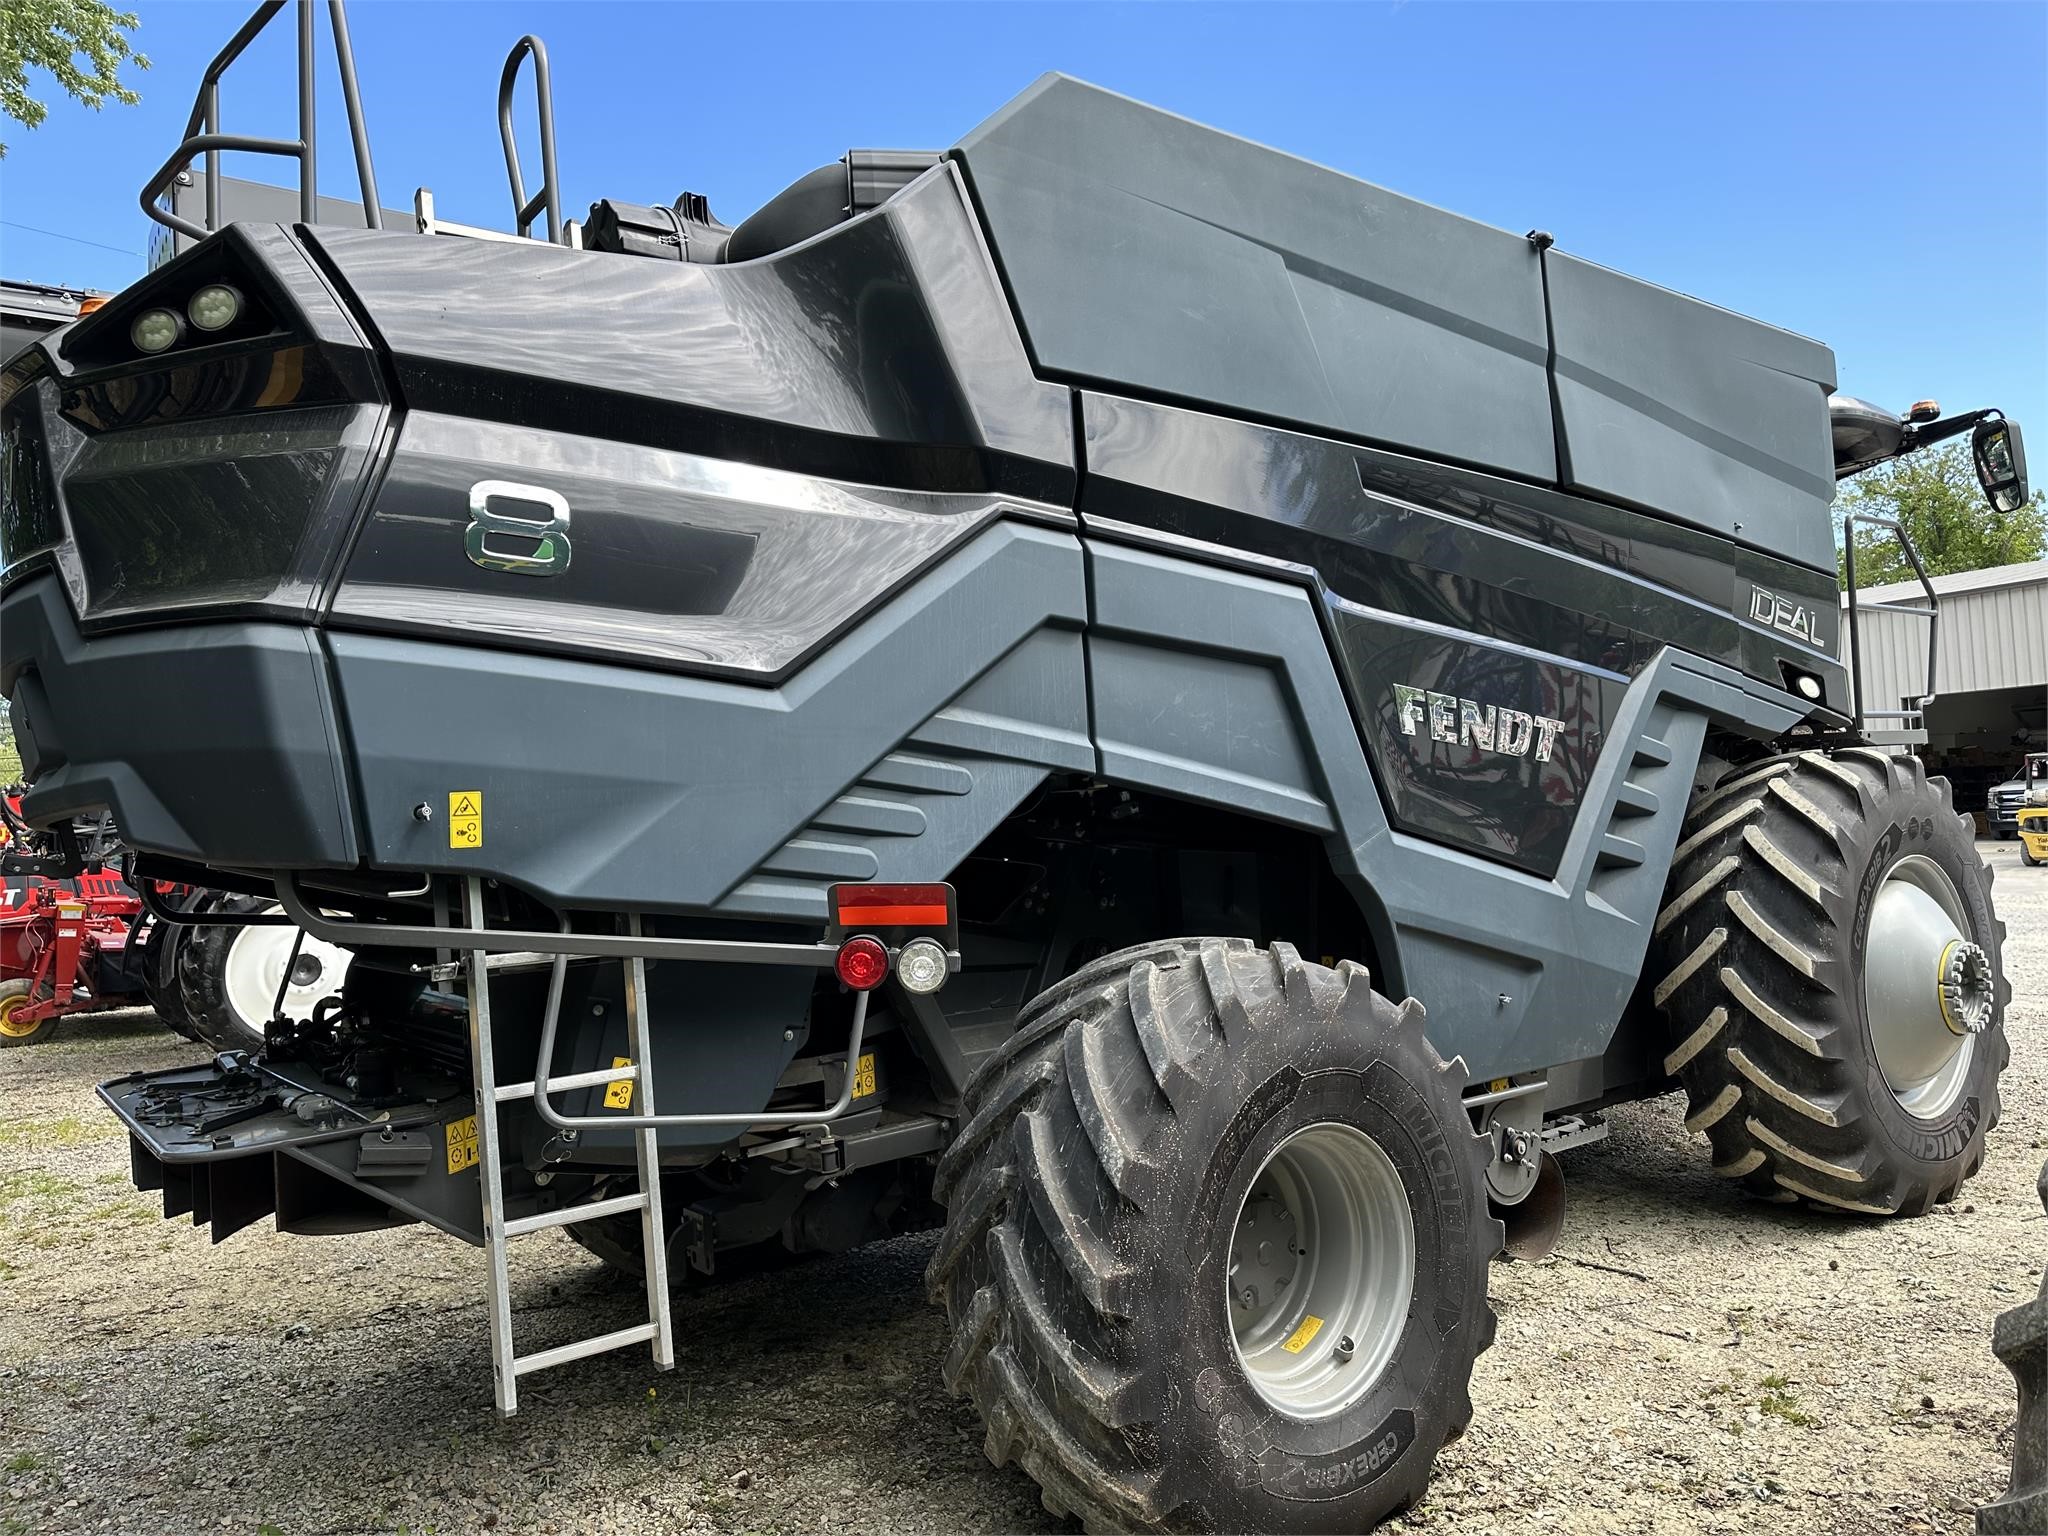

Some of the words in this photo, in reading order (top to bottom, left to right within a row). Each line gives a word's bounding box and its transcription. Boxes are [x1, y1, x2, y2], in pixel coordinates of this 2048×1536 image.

[464, 480, 571, 577] 8
[1749, 584, 1825, 648] IDEAL
[1392, 682, 1566, 763] FENDT
[1305, 1431, 1399, 1489] CEREXBIB
